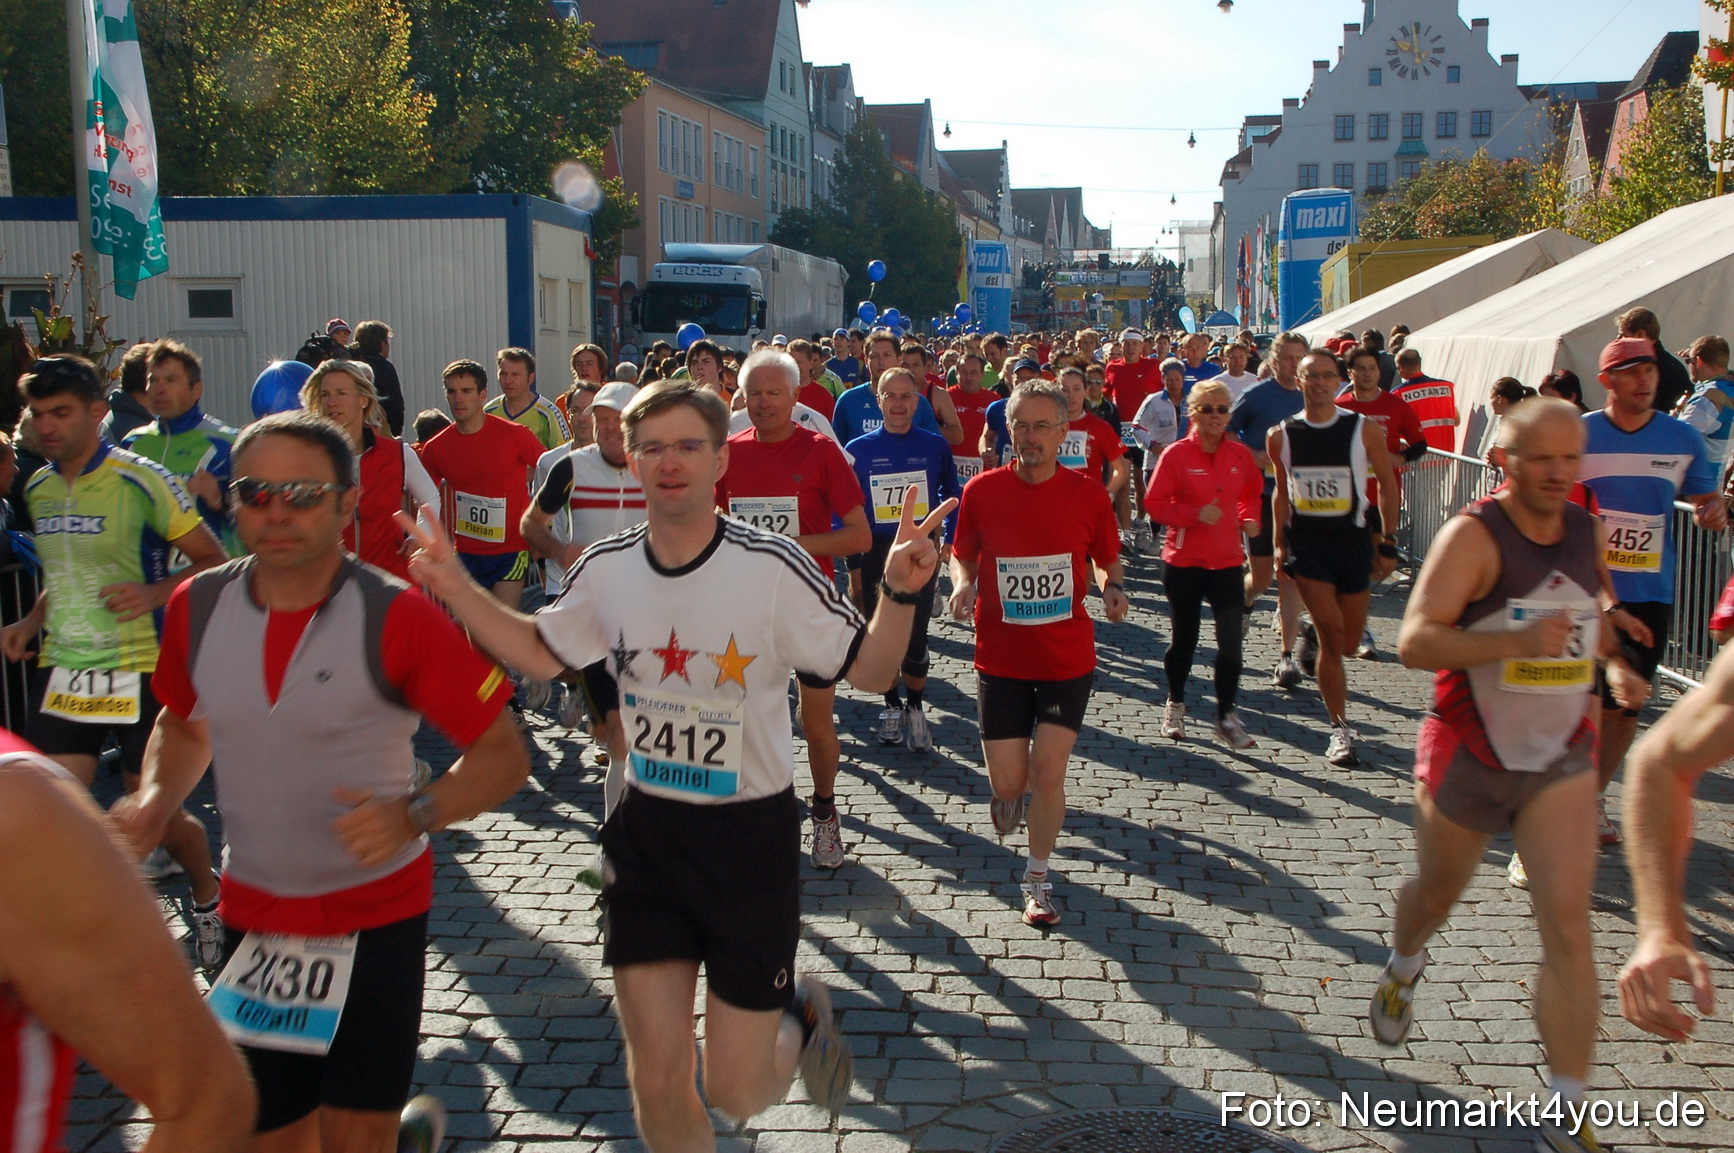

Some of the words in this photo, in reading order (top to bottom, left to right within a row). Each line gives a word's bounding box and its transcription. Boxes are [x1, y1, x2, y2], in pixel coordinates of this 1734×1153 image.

[1295, 201, 1348, 230] maxi
[673, 265, 724, 277] BOCK
[985, 275, 999, 286] dsl
[1403, 387, 1450, 402] NOTARZT
[883, 485, 912, 505] 77
[1303, 479, 1339, 499] 165
[470, 506, 489, 525] 60
[465, 521, 494, 536] Florian
[1607, 527, 1653, 552] 452
[1007, 562, 1040, 571] PFLEIDERER
[1607, 549, 1648, 565] Martin
[1006, 572, 1065, 601] 2982
[1016, 601, 1059, 617] Rainer
[634, 713, 727, 768] 2412
[645, 758, 711, 790] Daniel
